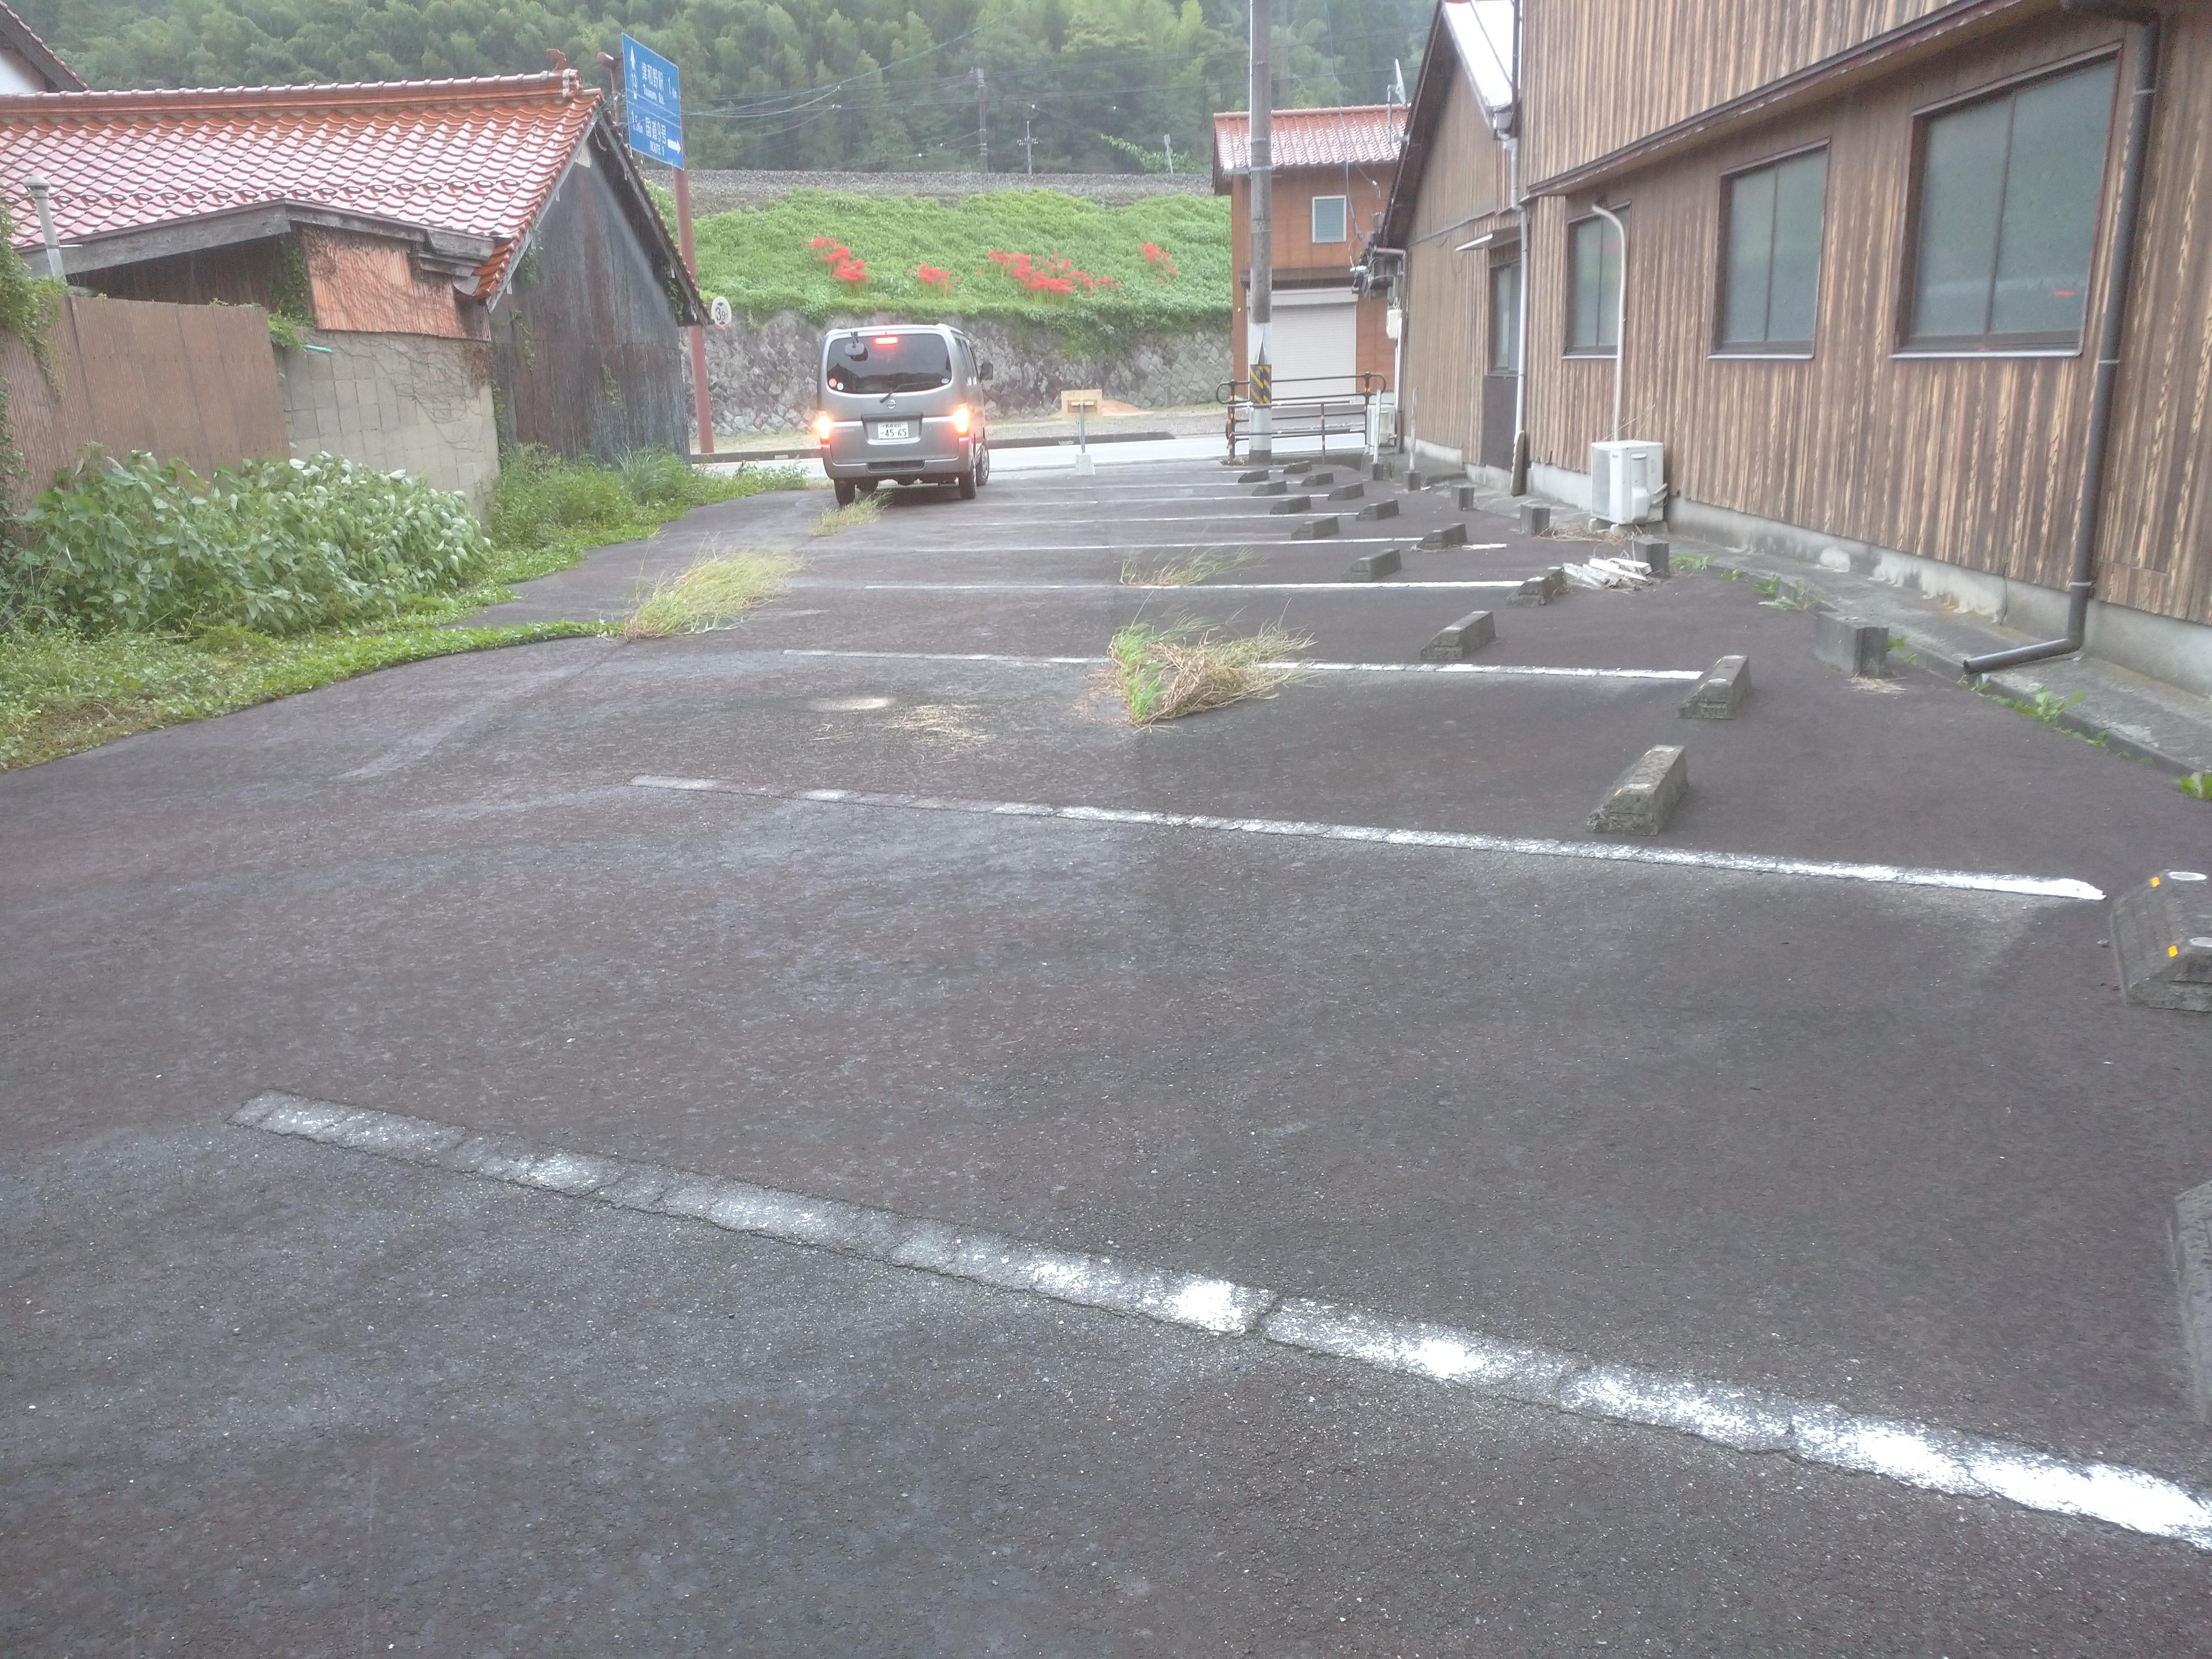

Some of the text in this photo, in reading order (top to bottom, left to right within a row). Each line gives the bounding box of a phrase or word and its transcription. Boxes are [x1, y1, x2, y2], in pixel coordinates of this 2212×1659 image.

[645, 116, 667, 144] 国道9号
[885, 428, 907, 437] 45-65
